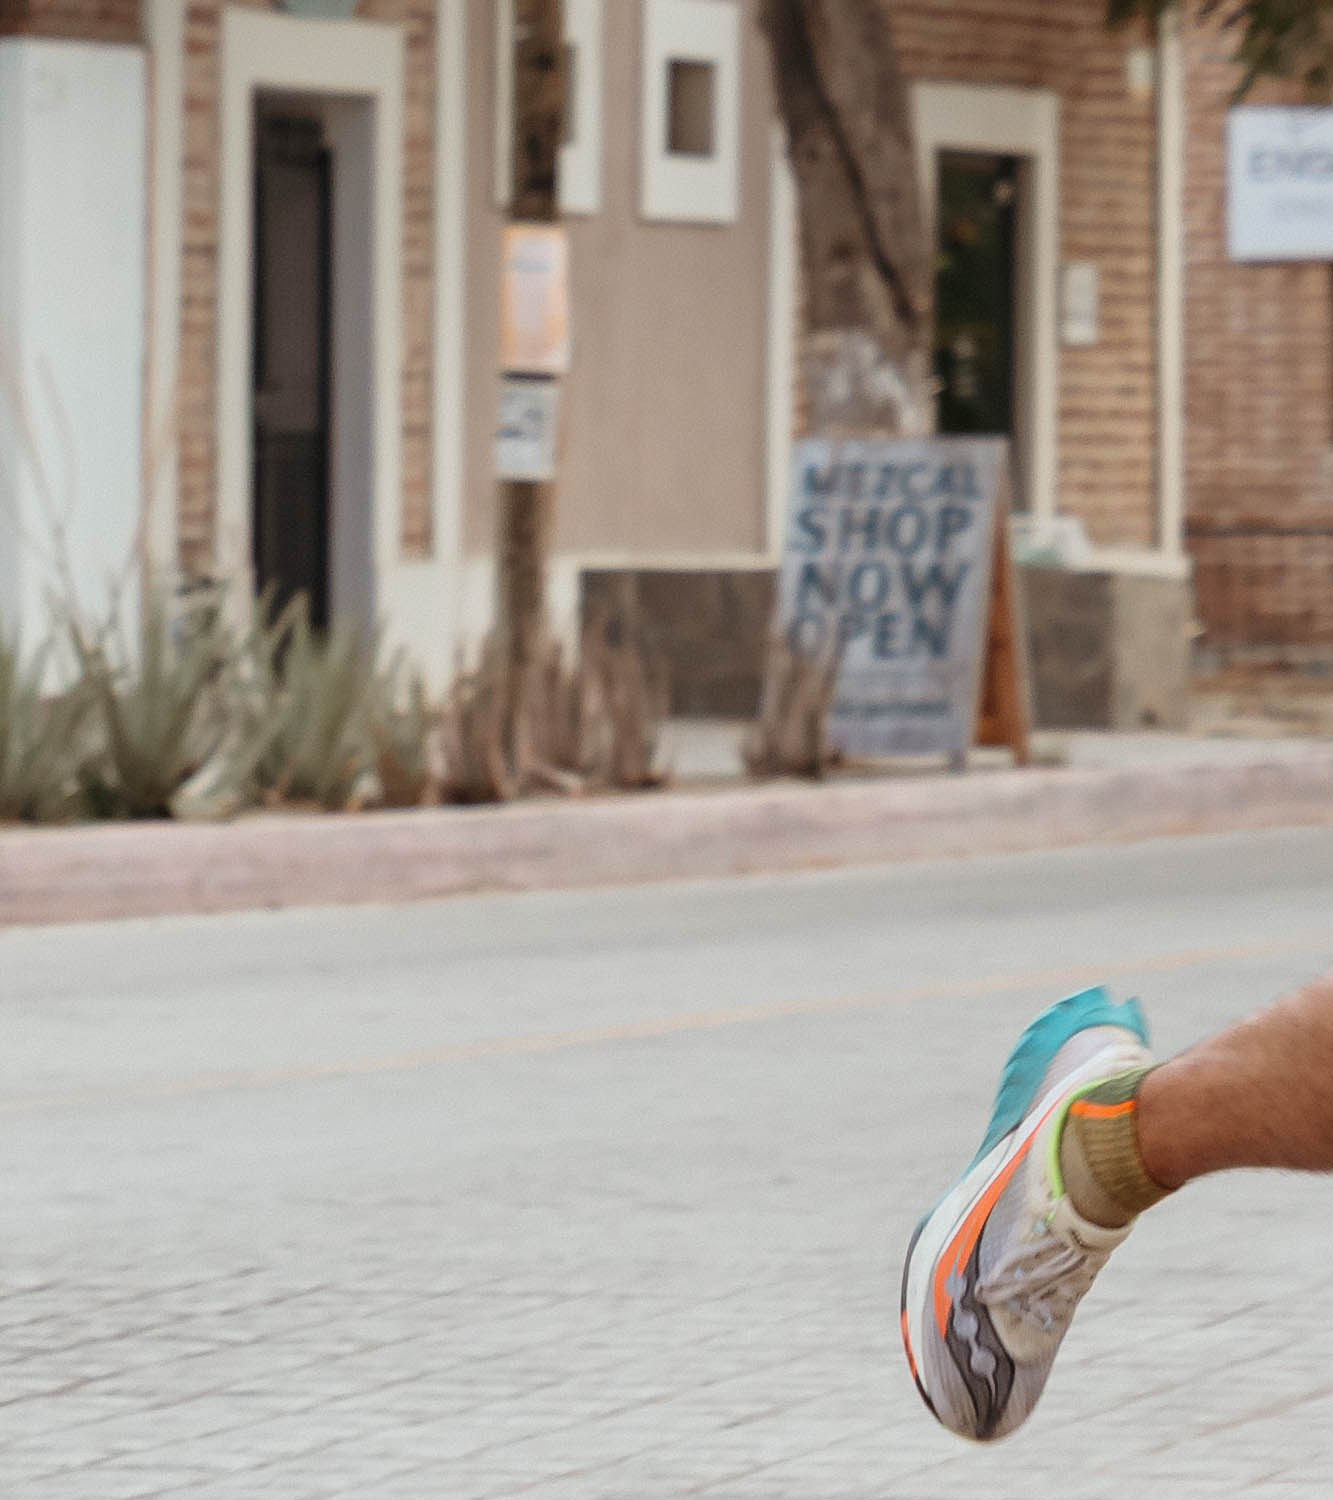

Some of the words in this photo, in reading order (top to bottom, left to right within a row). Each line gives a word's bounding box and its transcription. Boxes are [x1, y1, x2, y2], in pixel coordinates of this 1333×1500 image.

[789, 503, 973, 555] SHOP
[795, 560, 971, 613] NOW
[786, 611, 950, 661] OPEN
